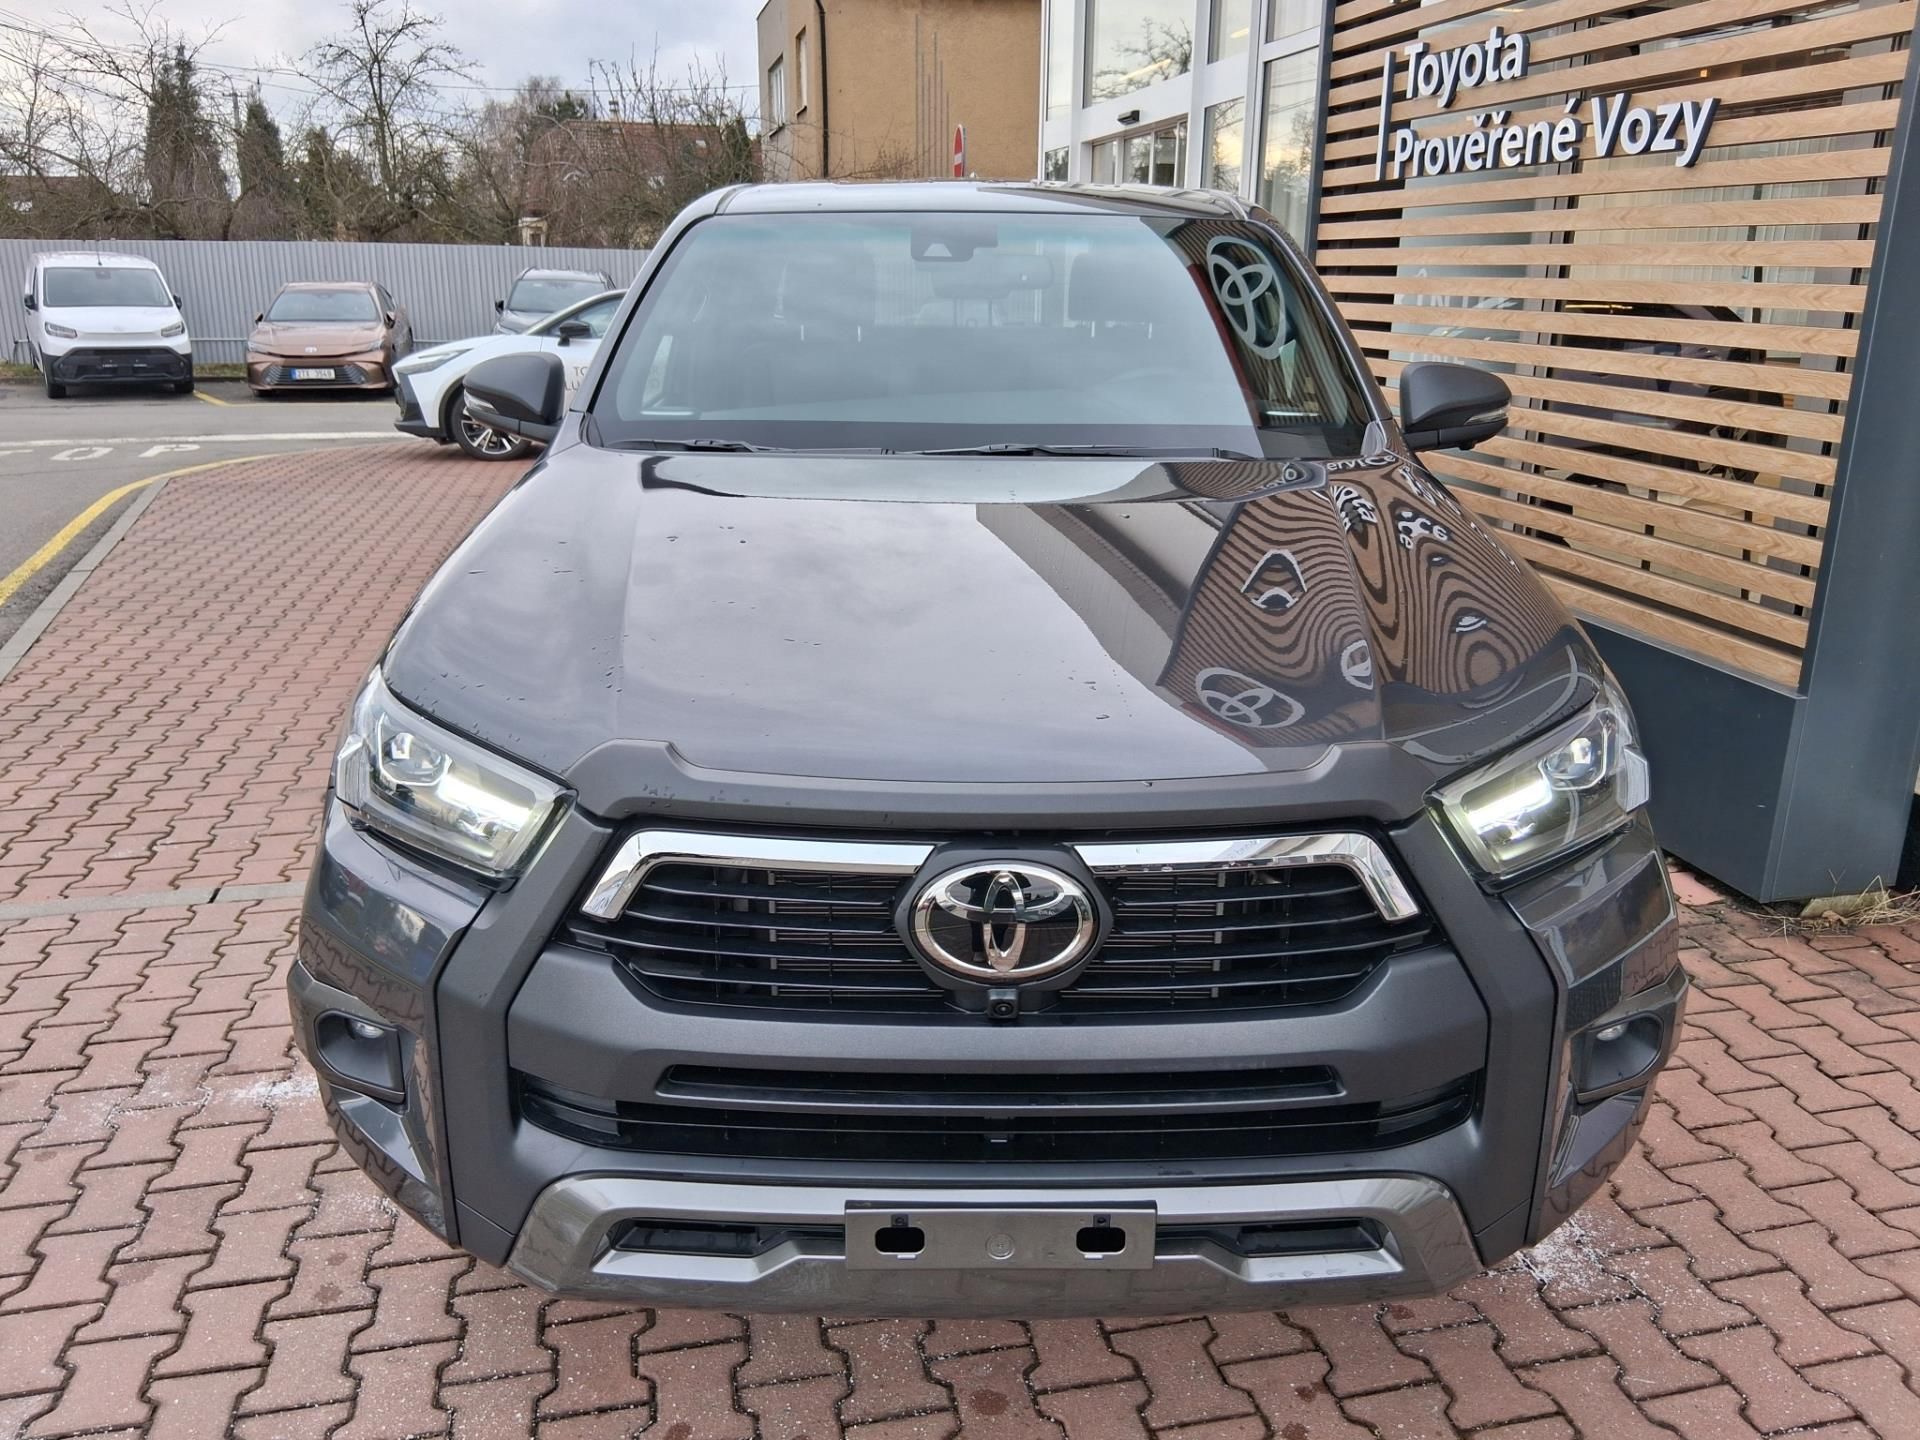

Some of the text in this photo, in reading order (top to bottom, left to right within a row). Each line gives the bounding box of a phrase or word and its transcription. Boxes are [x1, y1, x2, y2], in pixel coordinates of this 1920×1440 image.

[1405, 26, 1530, 108] Toyota
[1394, 93, 1721, 178] Prověřené Vozy
